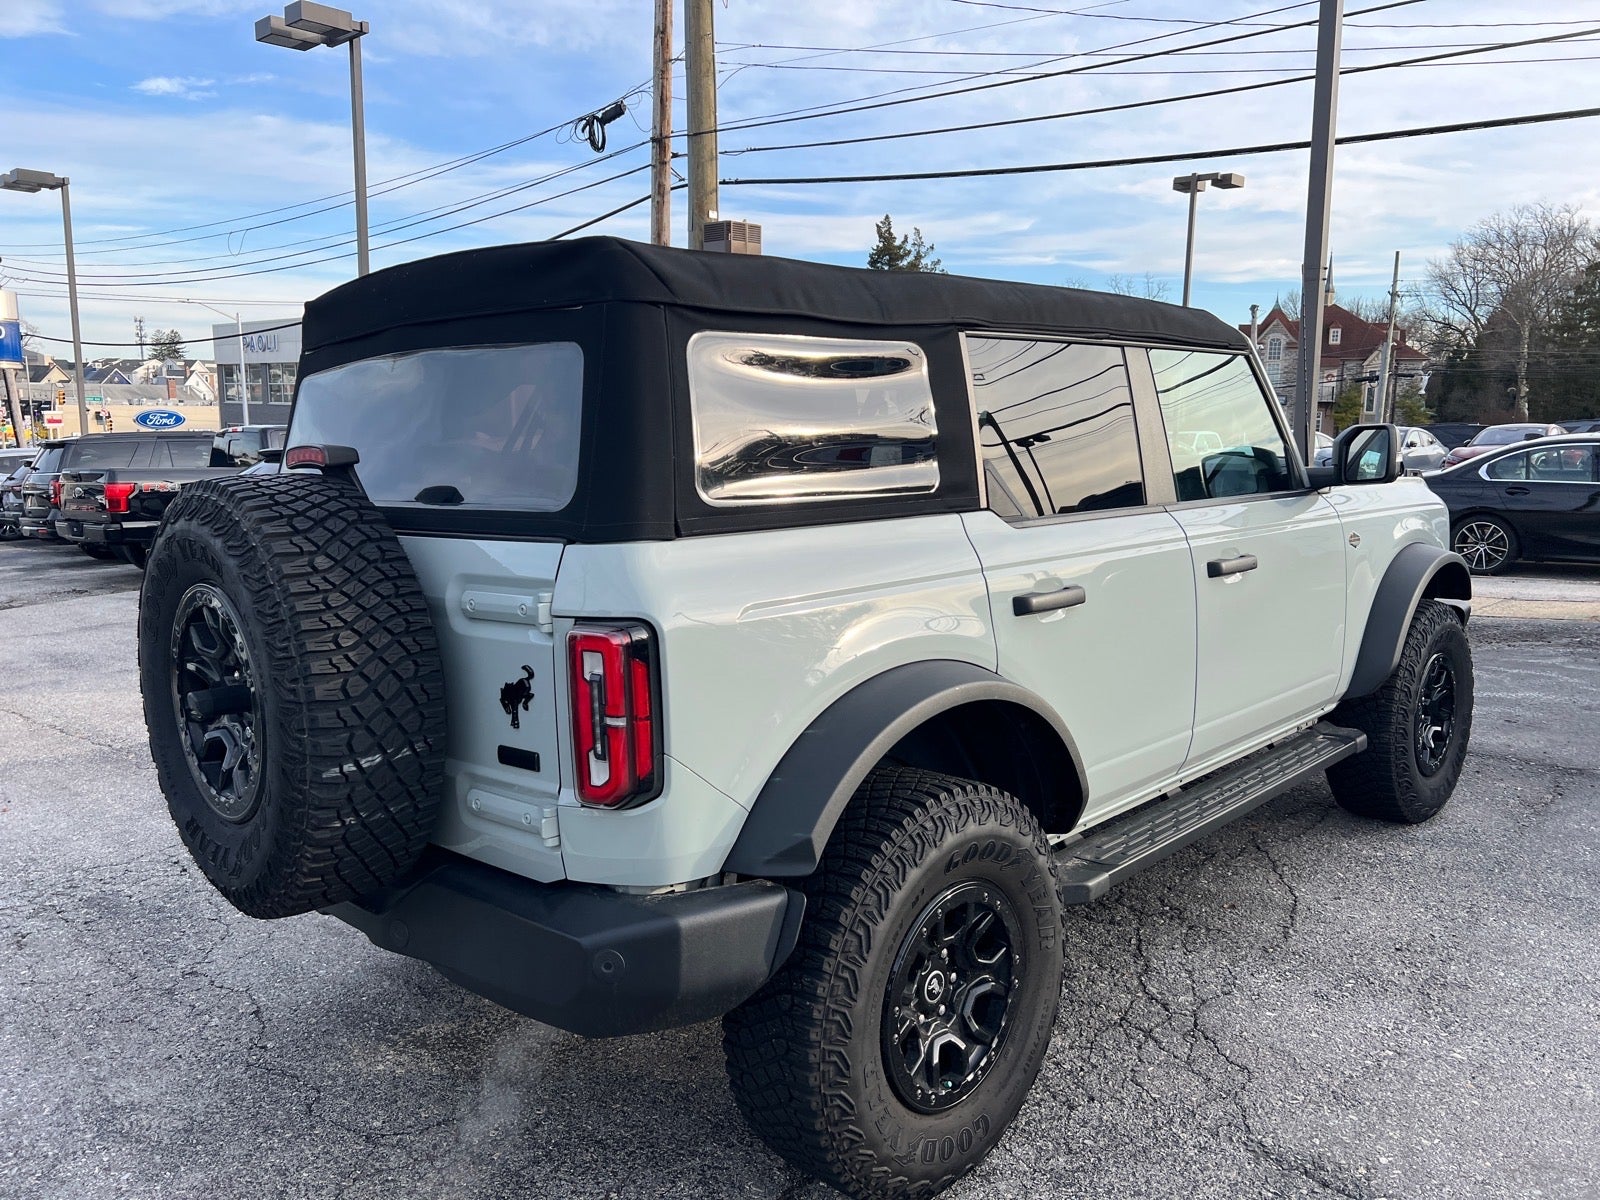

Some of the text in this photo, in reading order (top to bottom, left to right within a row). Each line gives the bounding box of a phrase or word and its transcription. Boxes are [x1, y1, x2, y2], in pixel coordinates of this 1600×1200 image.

[243, 334, 277, 352] PAOLI
[142, 482, 181, 493] FX4
[944, 841, 1056, 951] GOODYEAR
[863, 1057, 992, 1167] GOODYEAR
